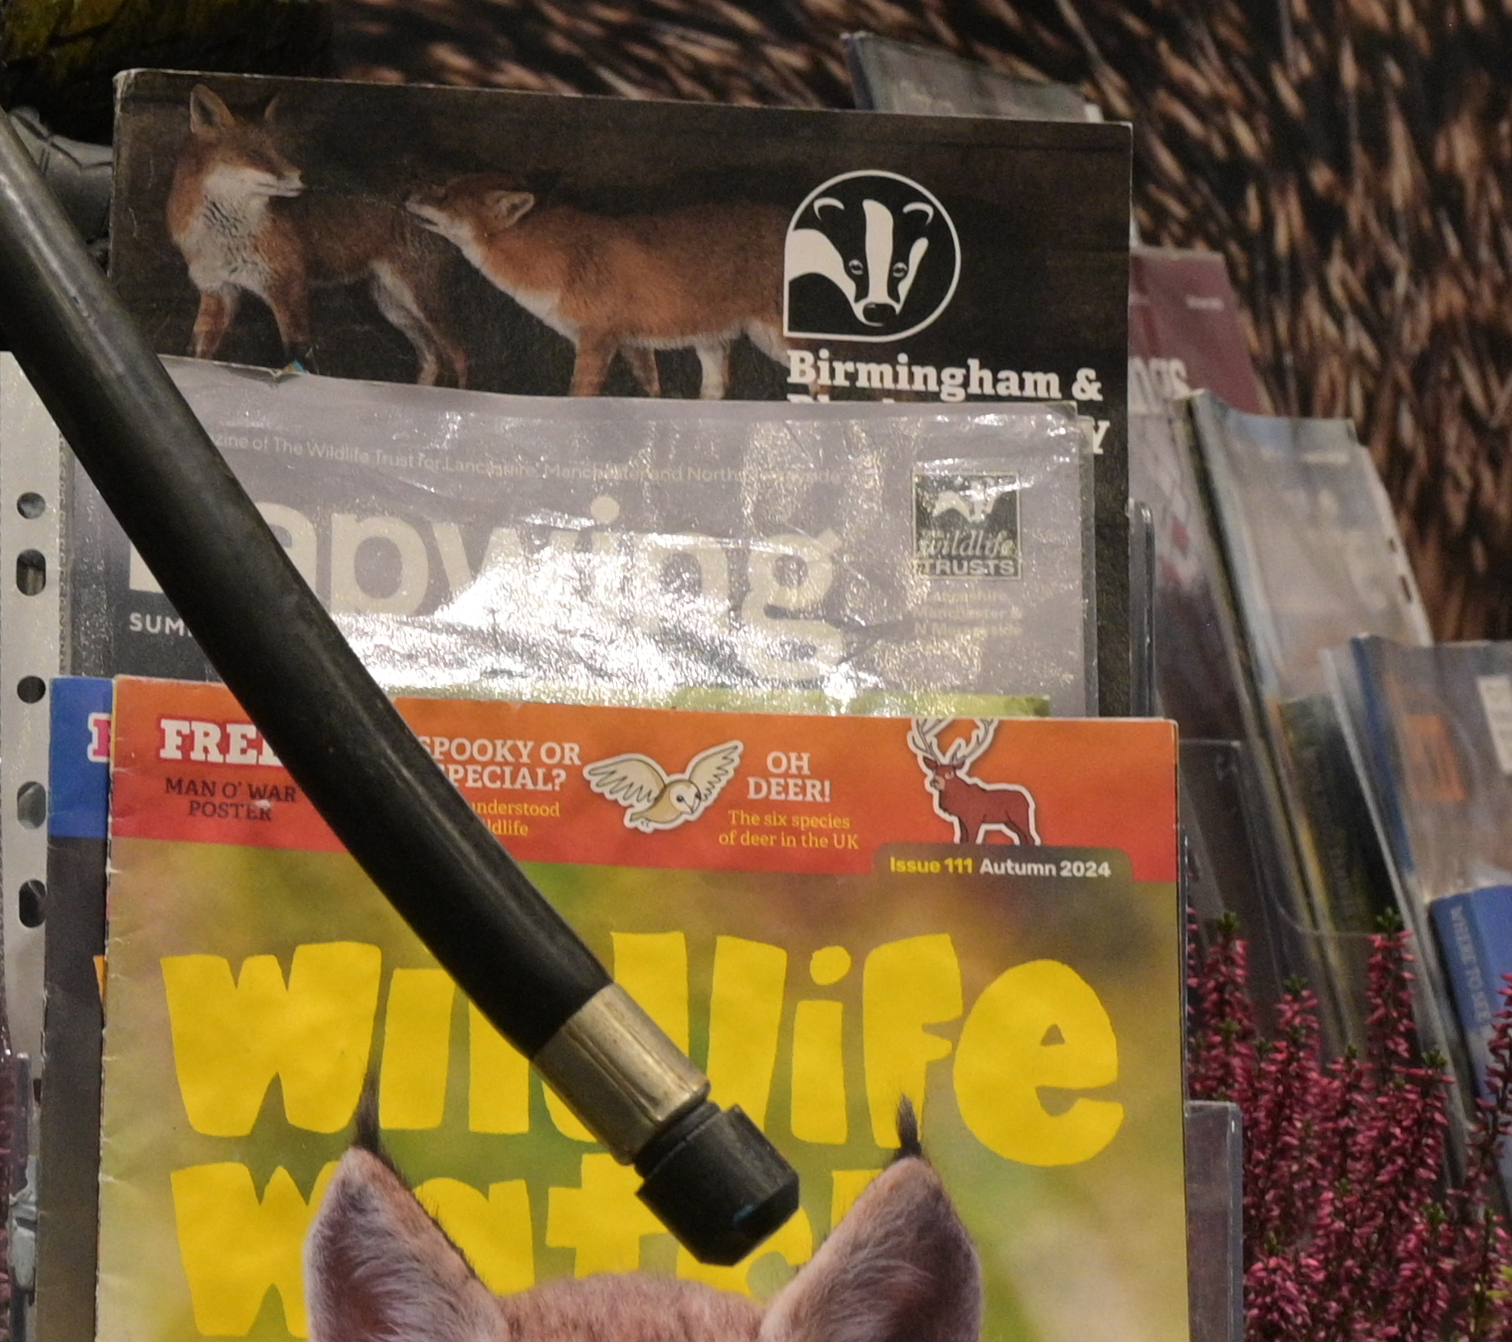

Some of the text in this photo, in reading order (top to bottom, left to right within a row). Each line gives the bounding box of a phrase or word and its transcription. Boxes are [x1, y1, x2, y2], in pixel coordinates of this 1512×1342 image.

[787, 348, 1062, 402] Birmingham
[1072, 367, 1103, 401] &
[214, 435, 248, 450] zine
[252, 437, 268, 451] of
[274, 437, 303, 456] The
[307, 441, 370, 464] Wildlife
[376, 448, 415, 469] Trust
[922, 559, 1015, 575] TRUSTS
[129, 612, 192, 637] SUM
[417, 735, 581, 765] SPOOKY OR
[765, 750, 811, 776] OH
[165, 777, 216, 797] MAN
[248, 783, 297, 802] WAR
[747, 776, 831, 803] DEER!
[189, 800, 271, 821] POSTER
[728, 809, 851, 832] The six species
[718, 830, 860, 850] of deer in the UK
[889, 856, 1111, 878] Issue 111 Autumn 2024
